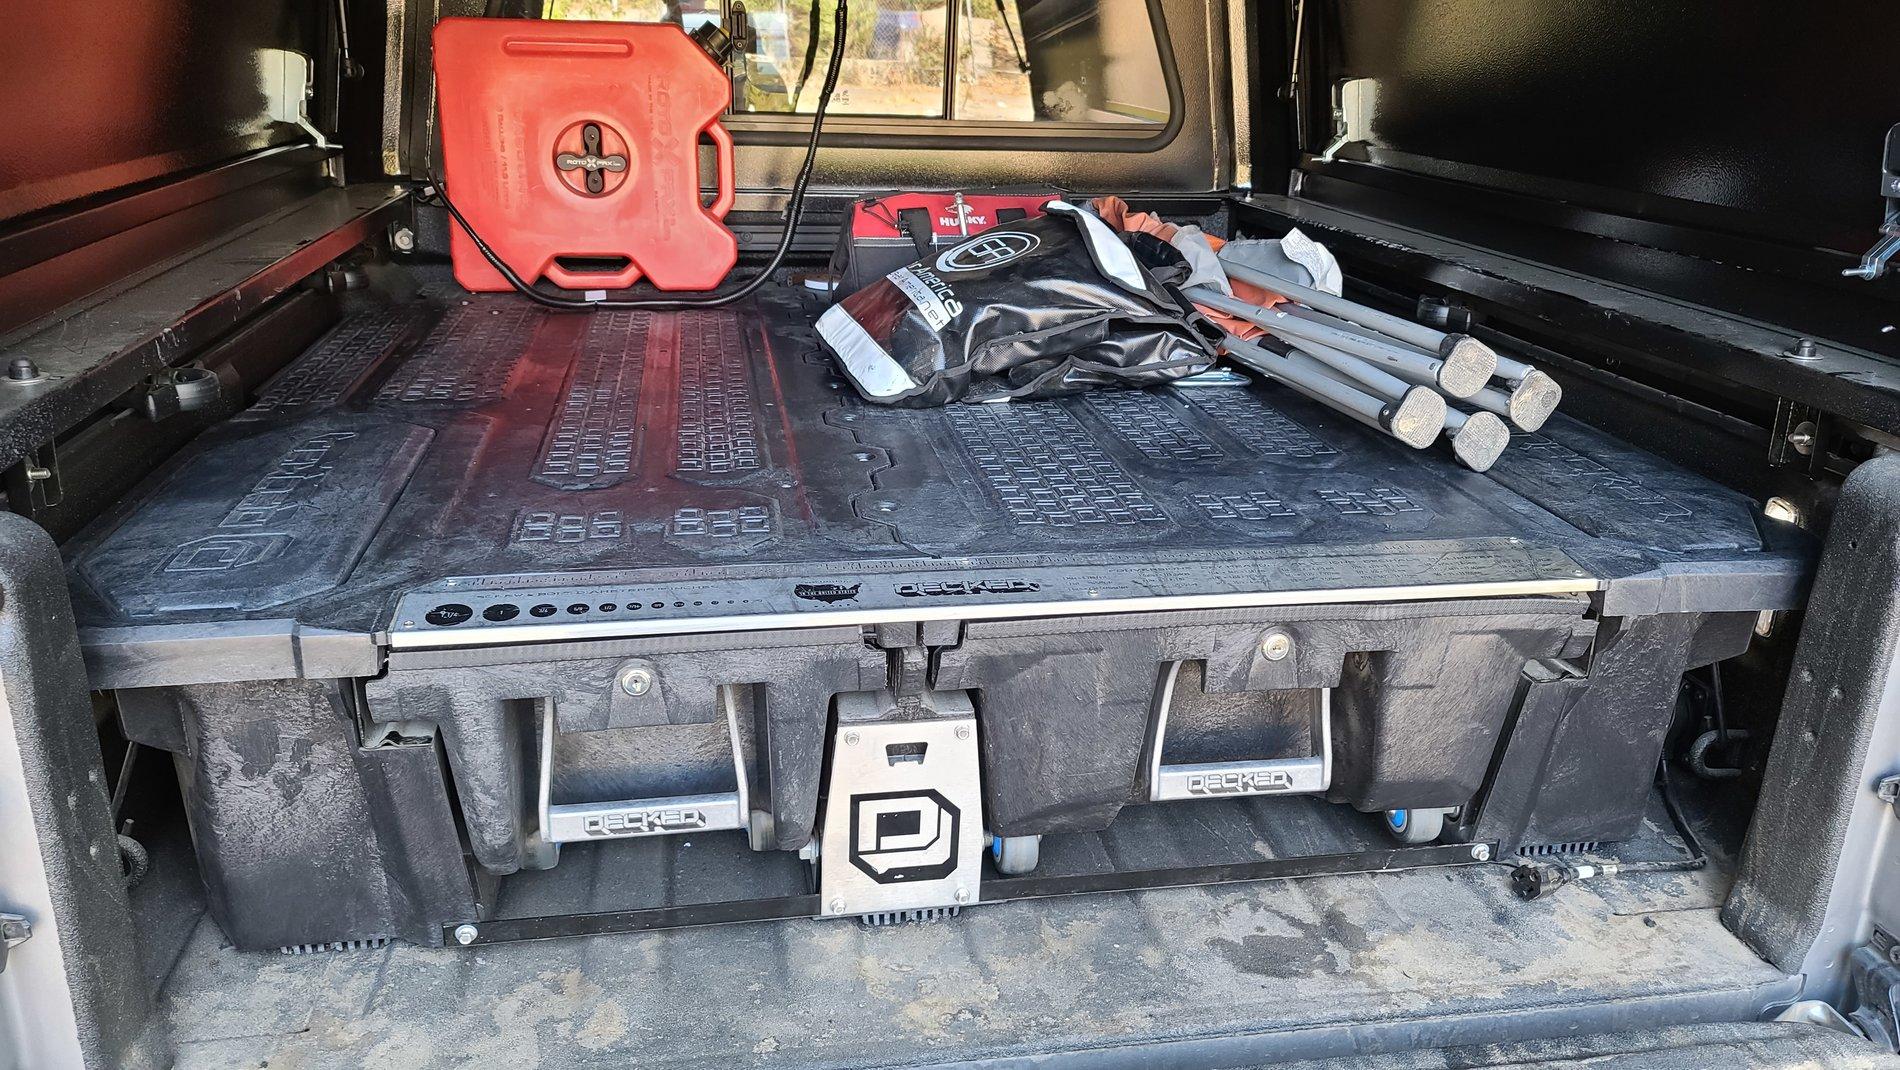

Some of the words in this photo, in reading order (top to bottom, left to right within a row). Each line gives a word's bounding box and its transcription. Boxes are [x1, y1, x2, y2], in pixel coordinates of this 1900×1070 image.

[893, 579, 1041, 597] DECKED
[1187, 771, 1293, 795] DECKED
[583, 809, 706, 836] DECKED
